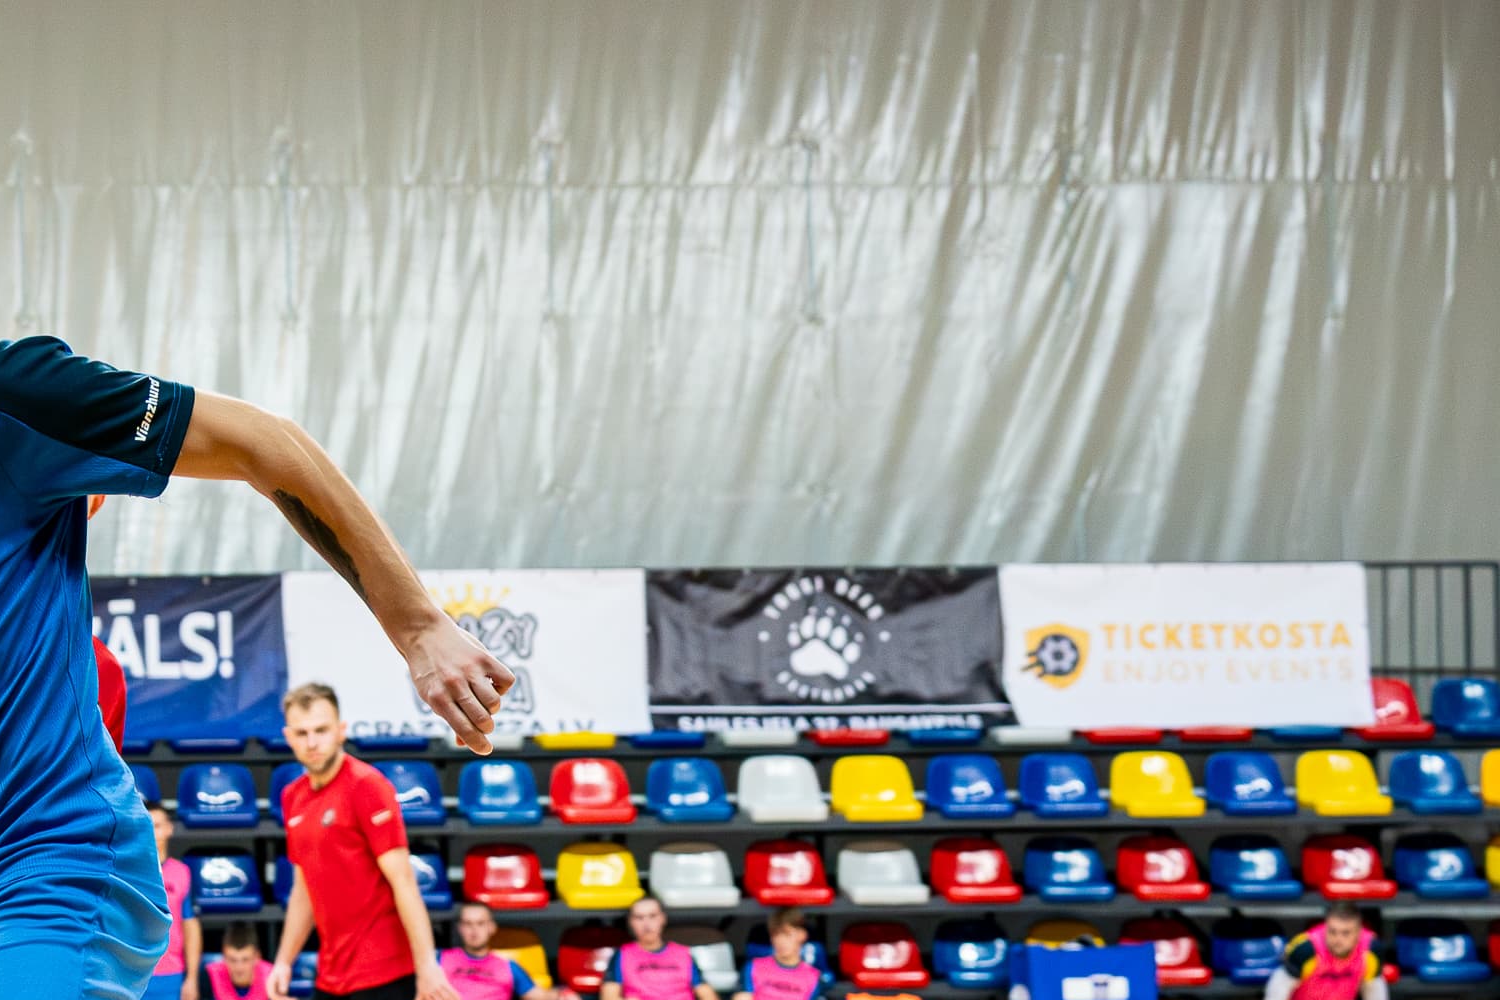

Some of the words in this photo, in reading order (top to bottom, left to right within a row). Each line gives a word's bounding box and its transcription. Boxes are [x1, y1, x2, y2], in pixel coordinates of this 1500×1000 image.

[93, 599, 234, 680] ĀLS!
[1100, 623, 1352, 650] TICKETKOSTA
[1103, 659, 1209, 683] ENJOY
[1226, 657, 1354, 682] EVENTS
